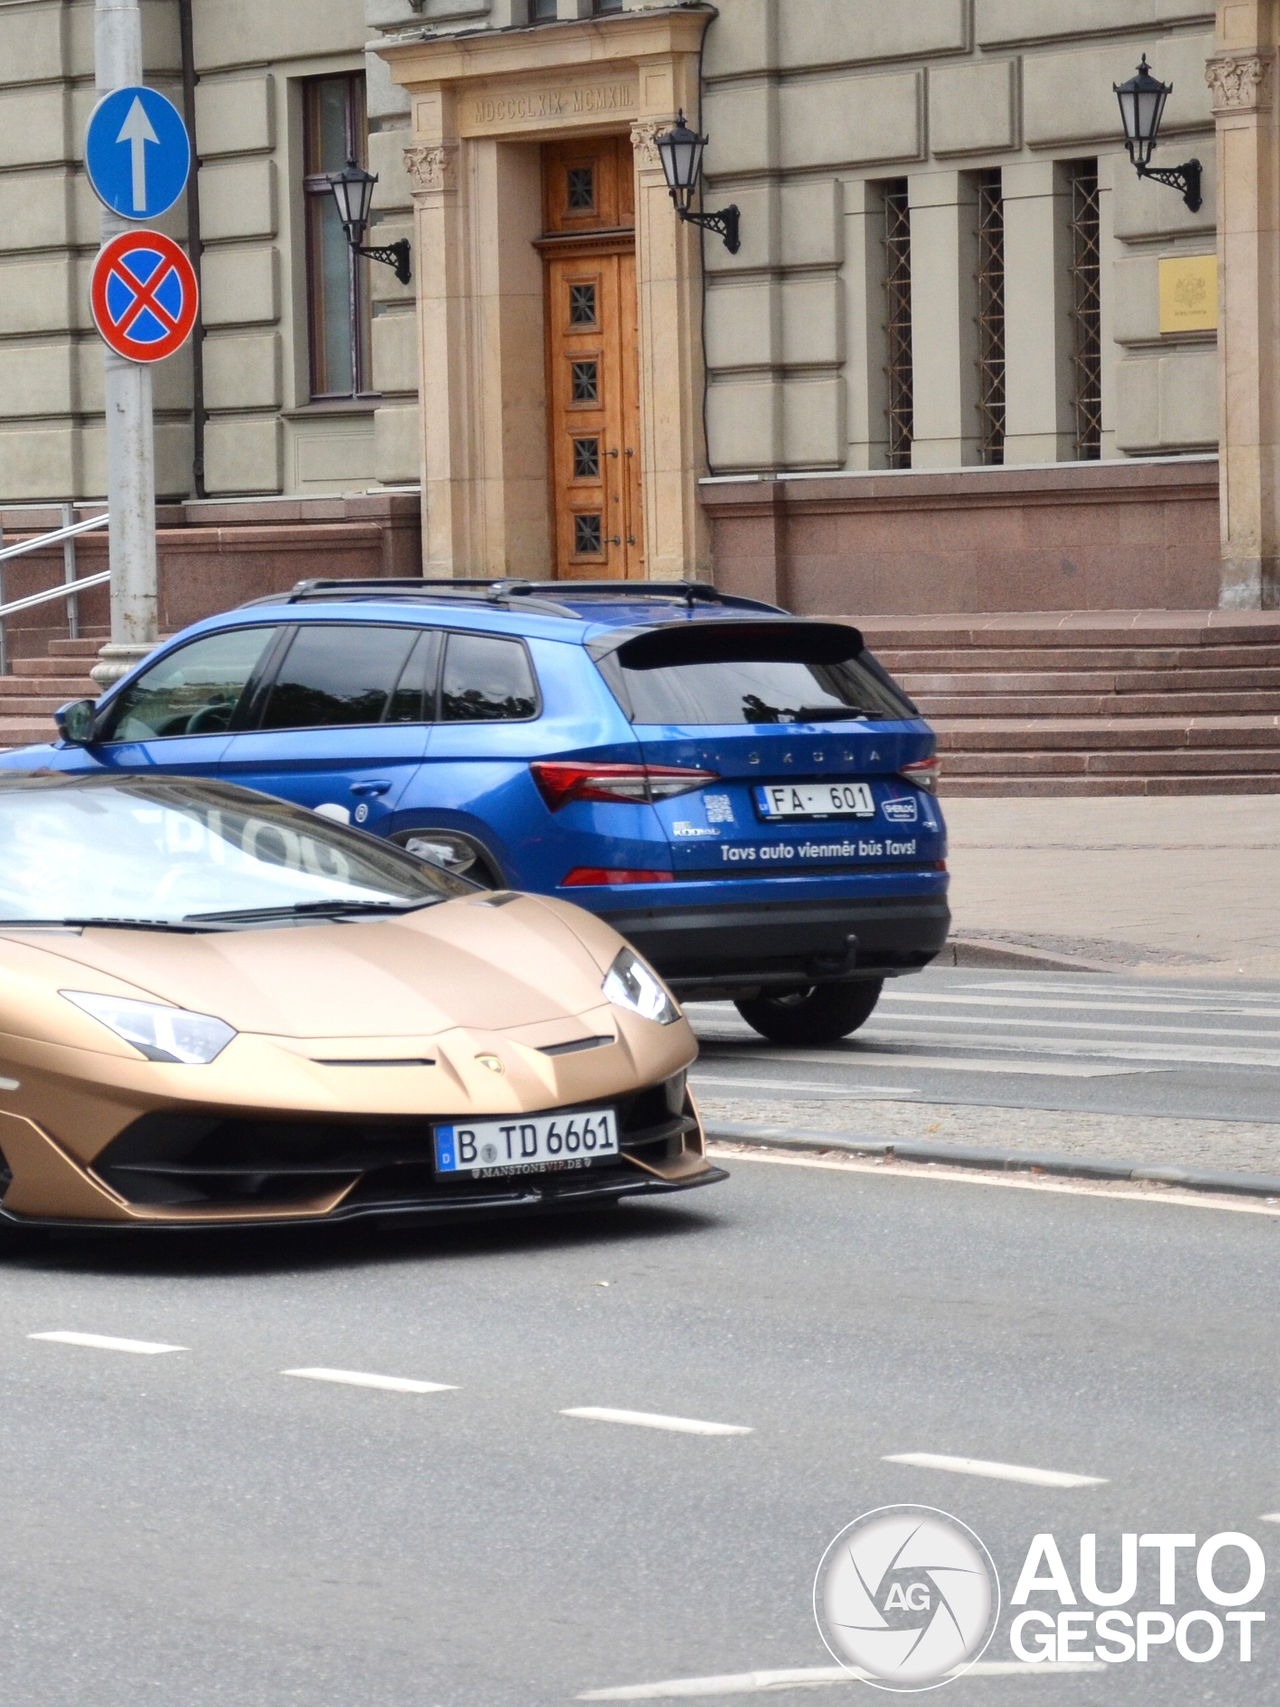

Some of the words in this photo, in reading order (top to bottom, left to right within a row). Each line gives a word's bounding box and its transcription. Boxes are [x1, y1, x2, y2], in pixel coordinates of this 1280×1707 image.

[721, 845, 756, 861] Tavs
[759, 843, 794, 859] auto
[798, 841, 856, 858] vienmēr
[858, 840, 882, 856] būs
[885, 839, 916, 855] Tavs!
[458, 1130, 478, 1163] B
[499, 1124, 537, 1159] TD
[547, 1116, 615, 1156] 6661
[442, 1153, 450, 1164] D
